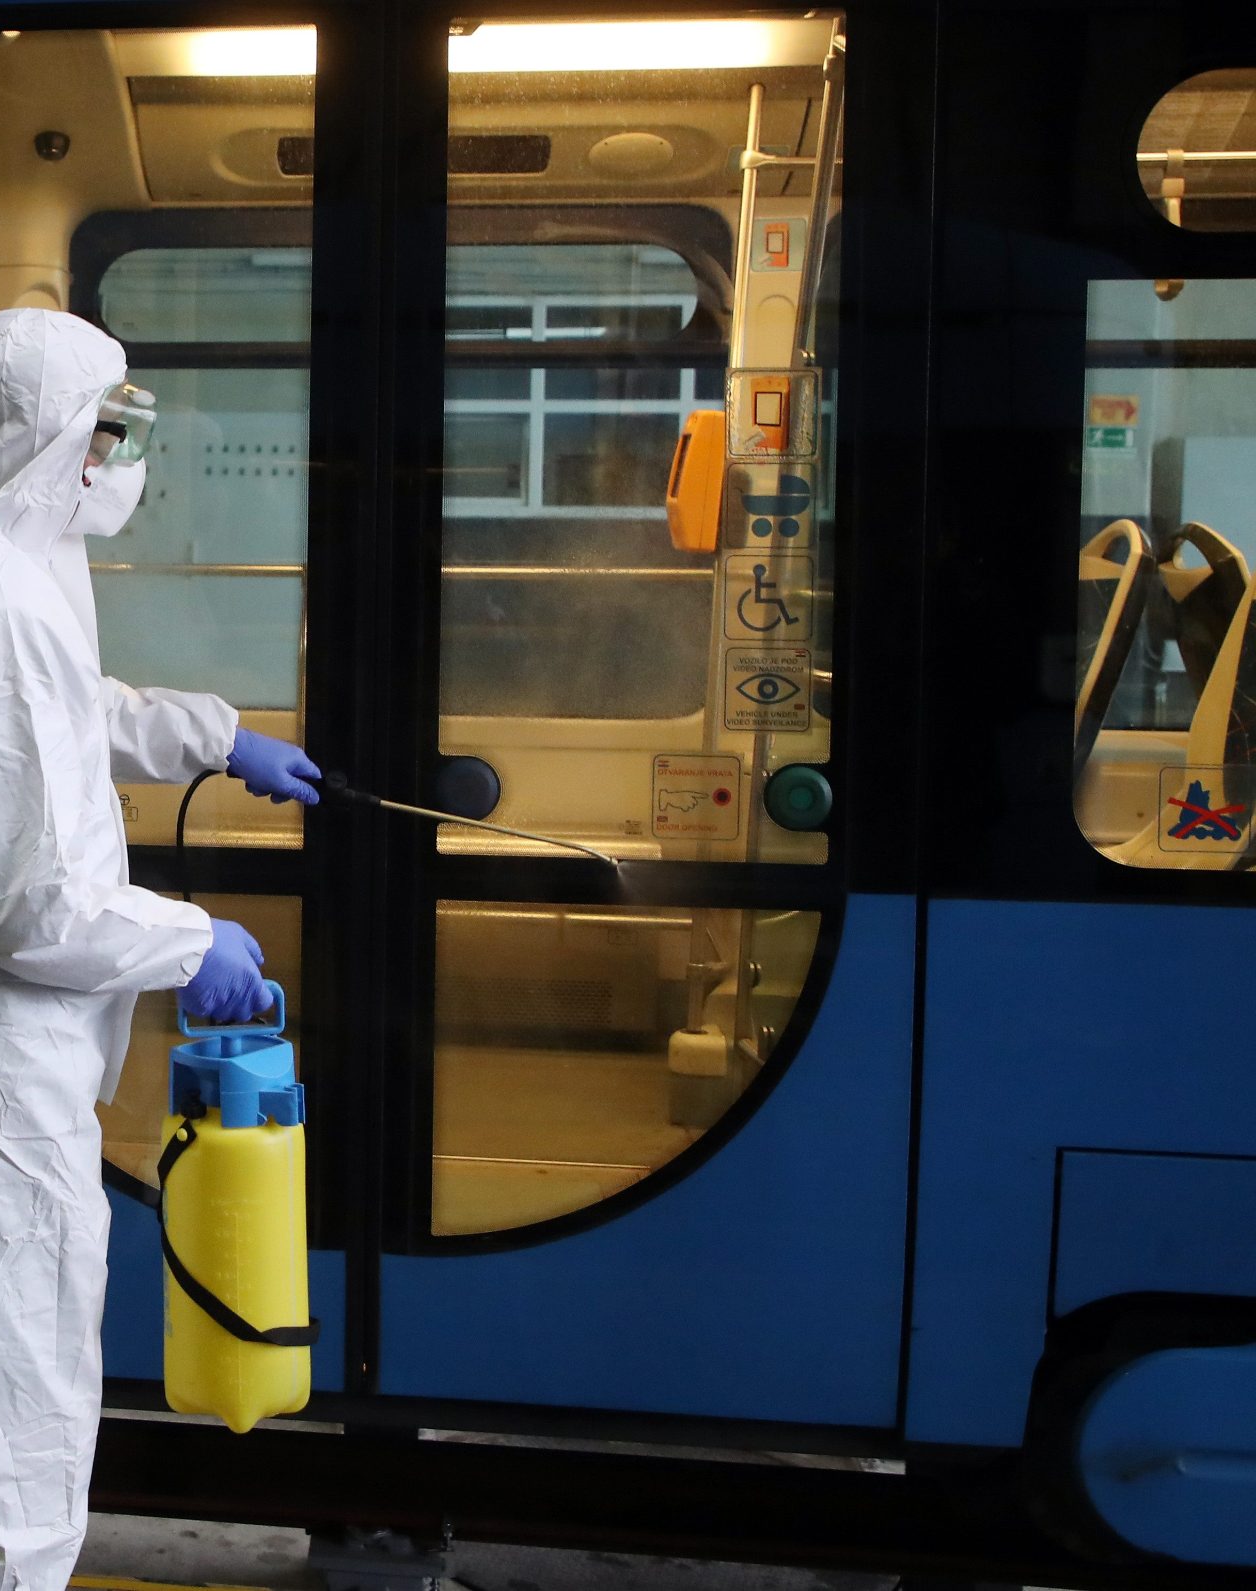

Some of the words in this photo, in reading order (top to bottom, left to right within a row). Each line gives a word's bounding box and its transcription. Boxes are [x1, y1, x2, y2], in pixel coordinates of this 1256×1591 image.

[736, 710, 768, 718] VEHICLE
[657, 768, 705, 777] OTVARANJE
[707, 769, 733, 777] VRATA
[656, 823, 680, 832] DOOR
[682, 824, 718, 832] OPENING
